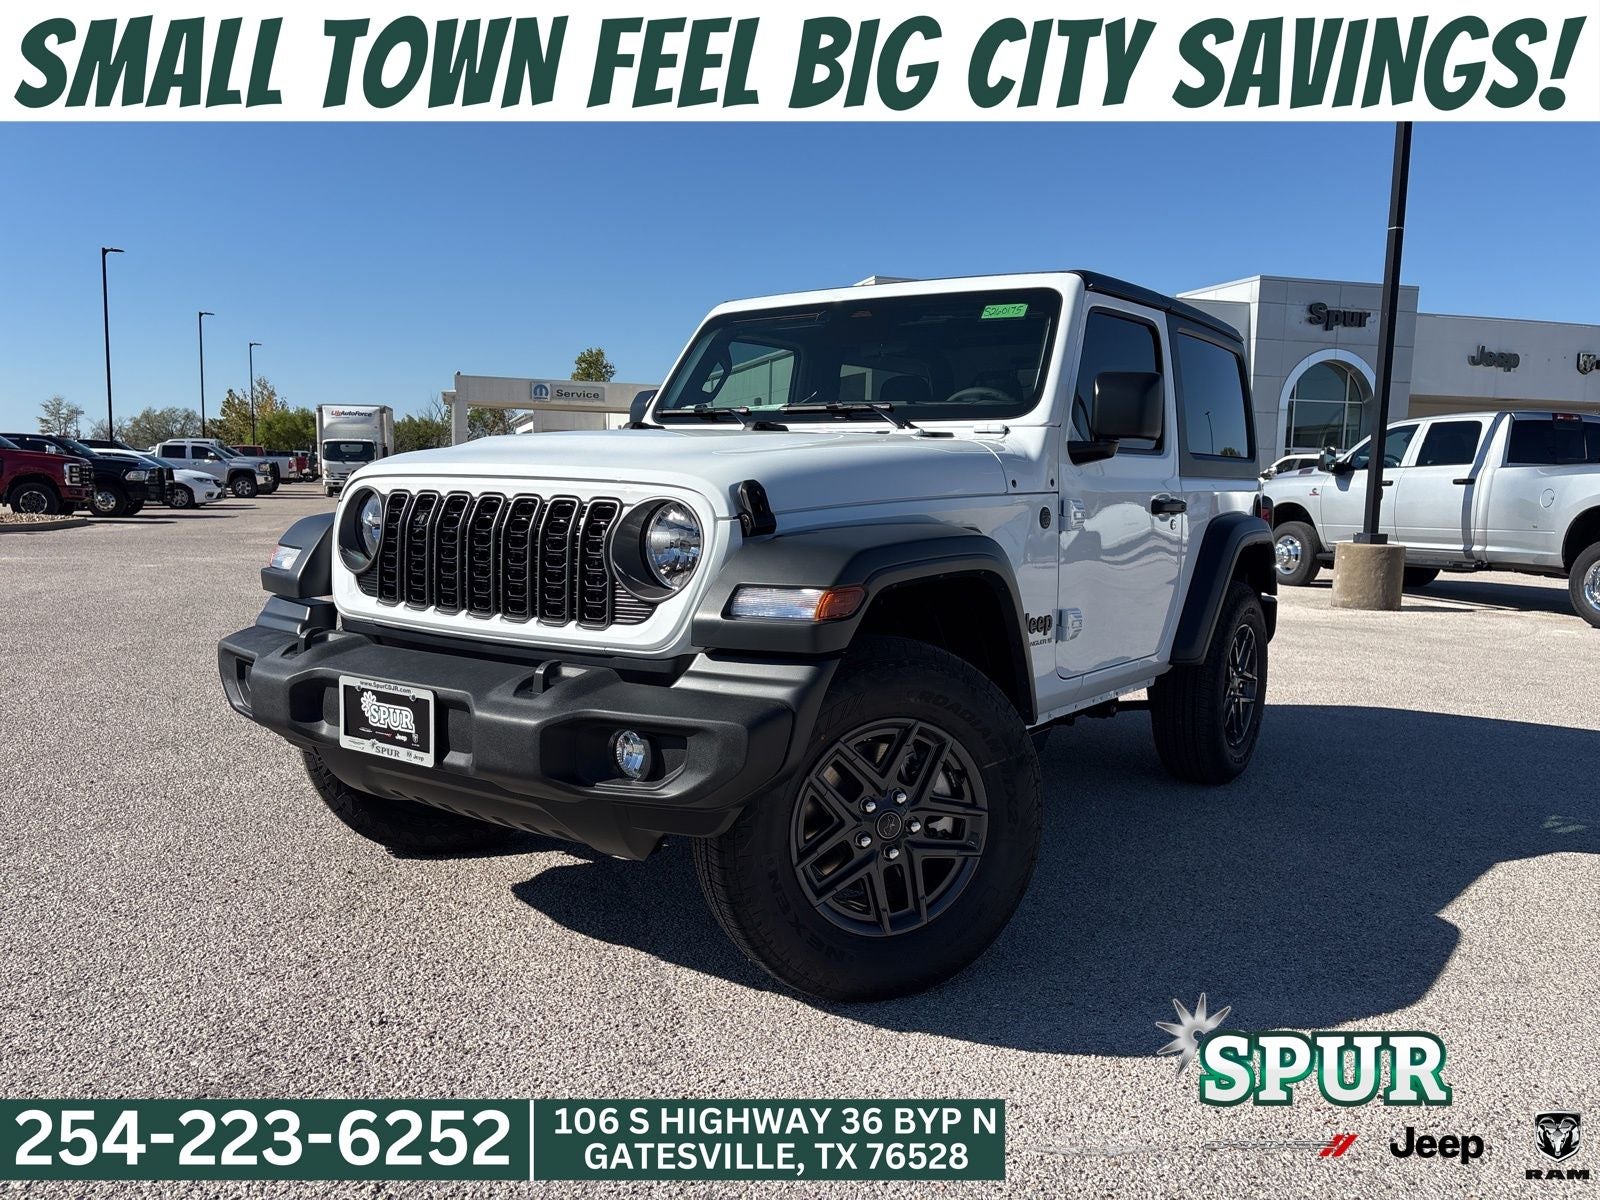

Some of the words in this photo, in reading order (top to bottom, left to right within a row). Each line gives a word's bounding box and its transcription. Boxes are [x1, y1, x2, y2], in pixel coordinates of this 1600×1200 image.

[1308, 302, 1371, 331] Spur
[1467, 345, 1520, 372] Jeep
[556, 389, 600, 399] Service
[369, 703, 414, 731] SPUR
[375, 745, 400, 758] SPUR
